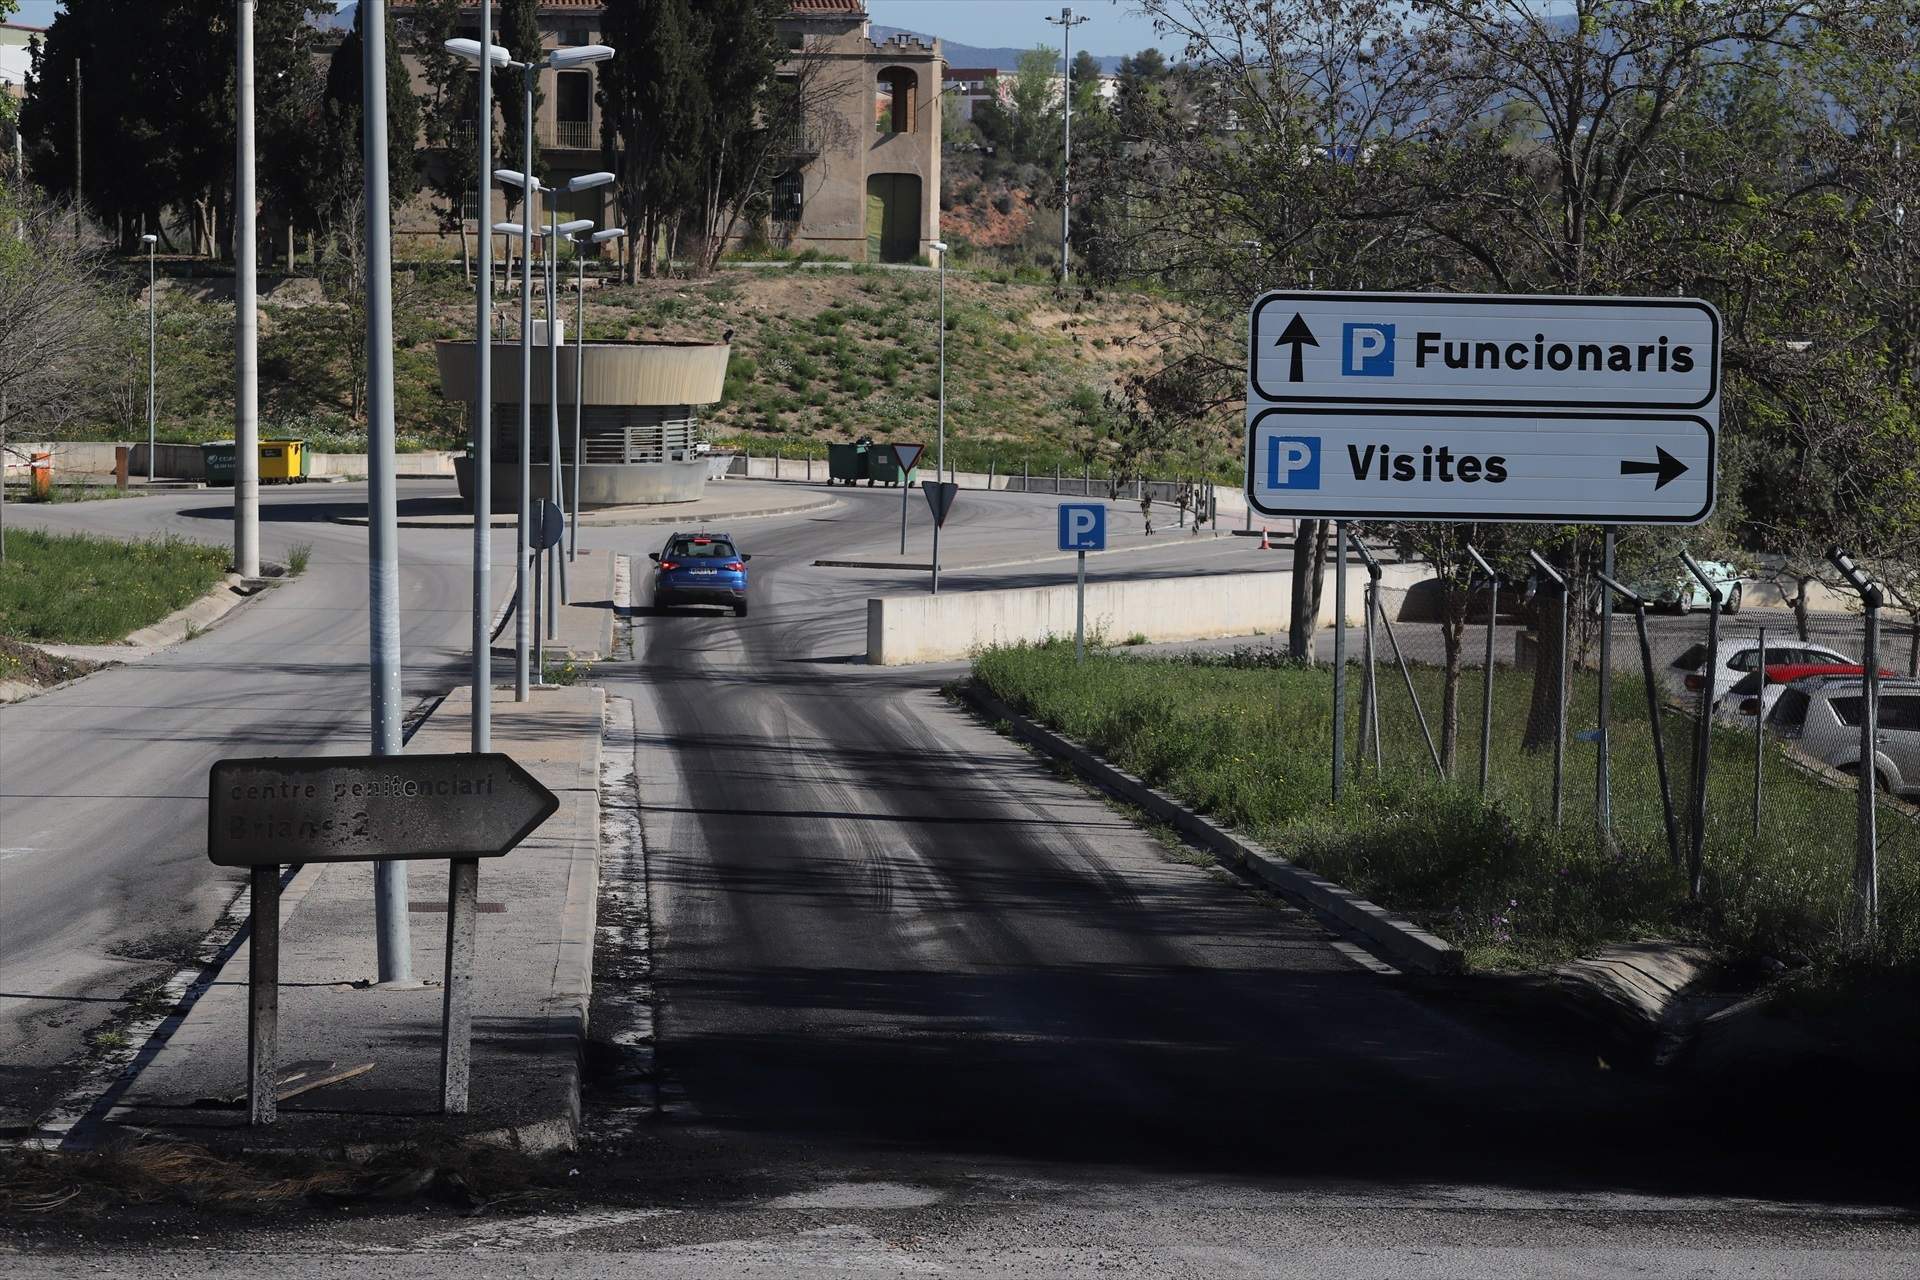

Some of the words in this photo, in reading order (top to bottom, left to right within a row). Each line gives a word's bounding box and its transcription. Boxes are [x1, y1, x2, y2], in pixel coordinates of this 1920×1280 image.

[1352, 328, 1386, 371] P
[1415, 331, 1695, 374] Funcionaris
[1277, 441, 1312, 484] P
[1347, 443, 1509, 484] Visites
[1068, 508, 1096, 546] P
[231, 779, 317, 801] centre
[333, 773, 495, 802] penitenciari
